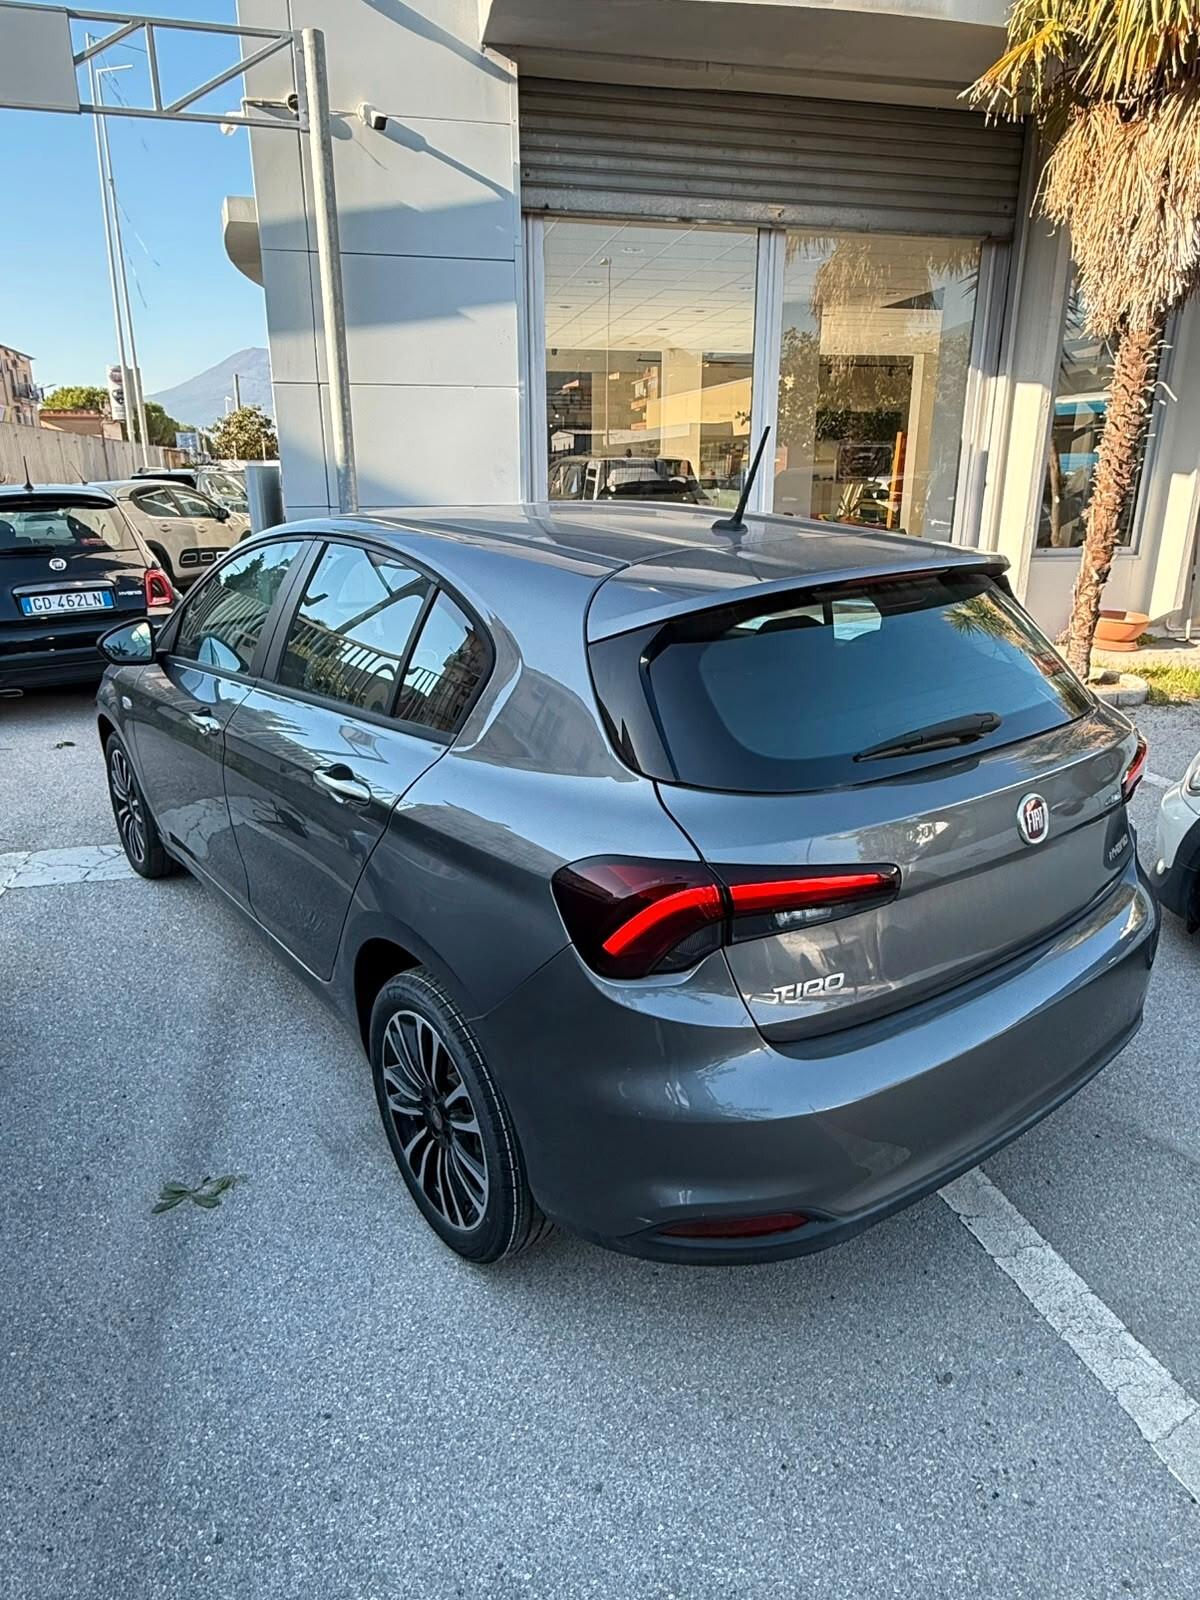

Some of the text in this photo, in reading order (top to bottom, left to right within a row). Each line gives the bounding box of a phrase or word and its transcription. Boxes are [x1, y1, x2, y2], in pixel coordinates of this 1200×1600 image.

[32, 592, 103, 611] GD 462LN
[1026, 806, 1044, 833] FIAT
[773, 972, 845, 1002] TIPO
